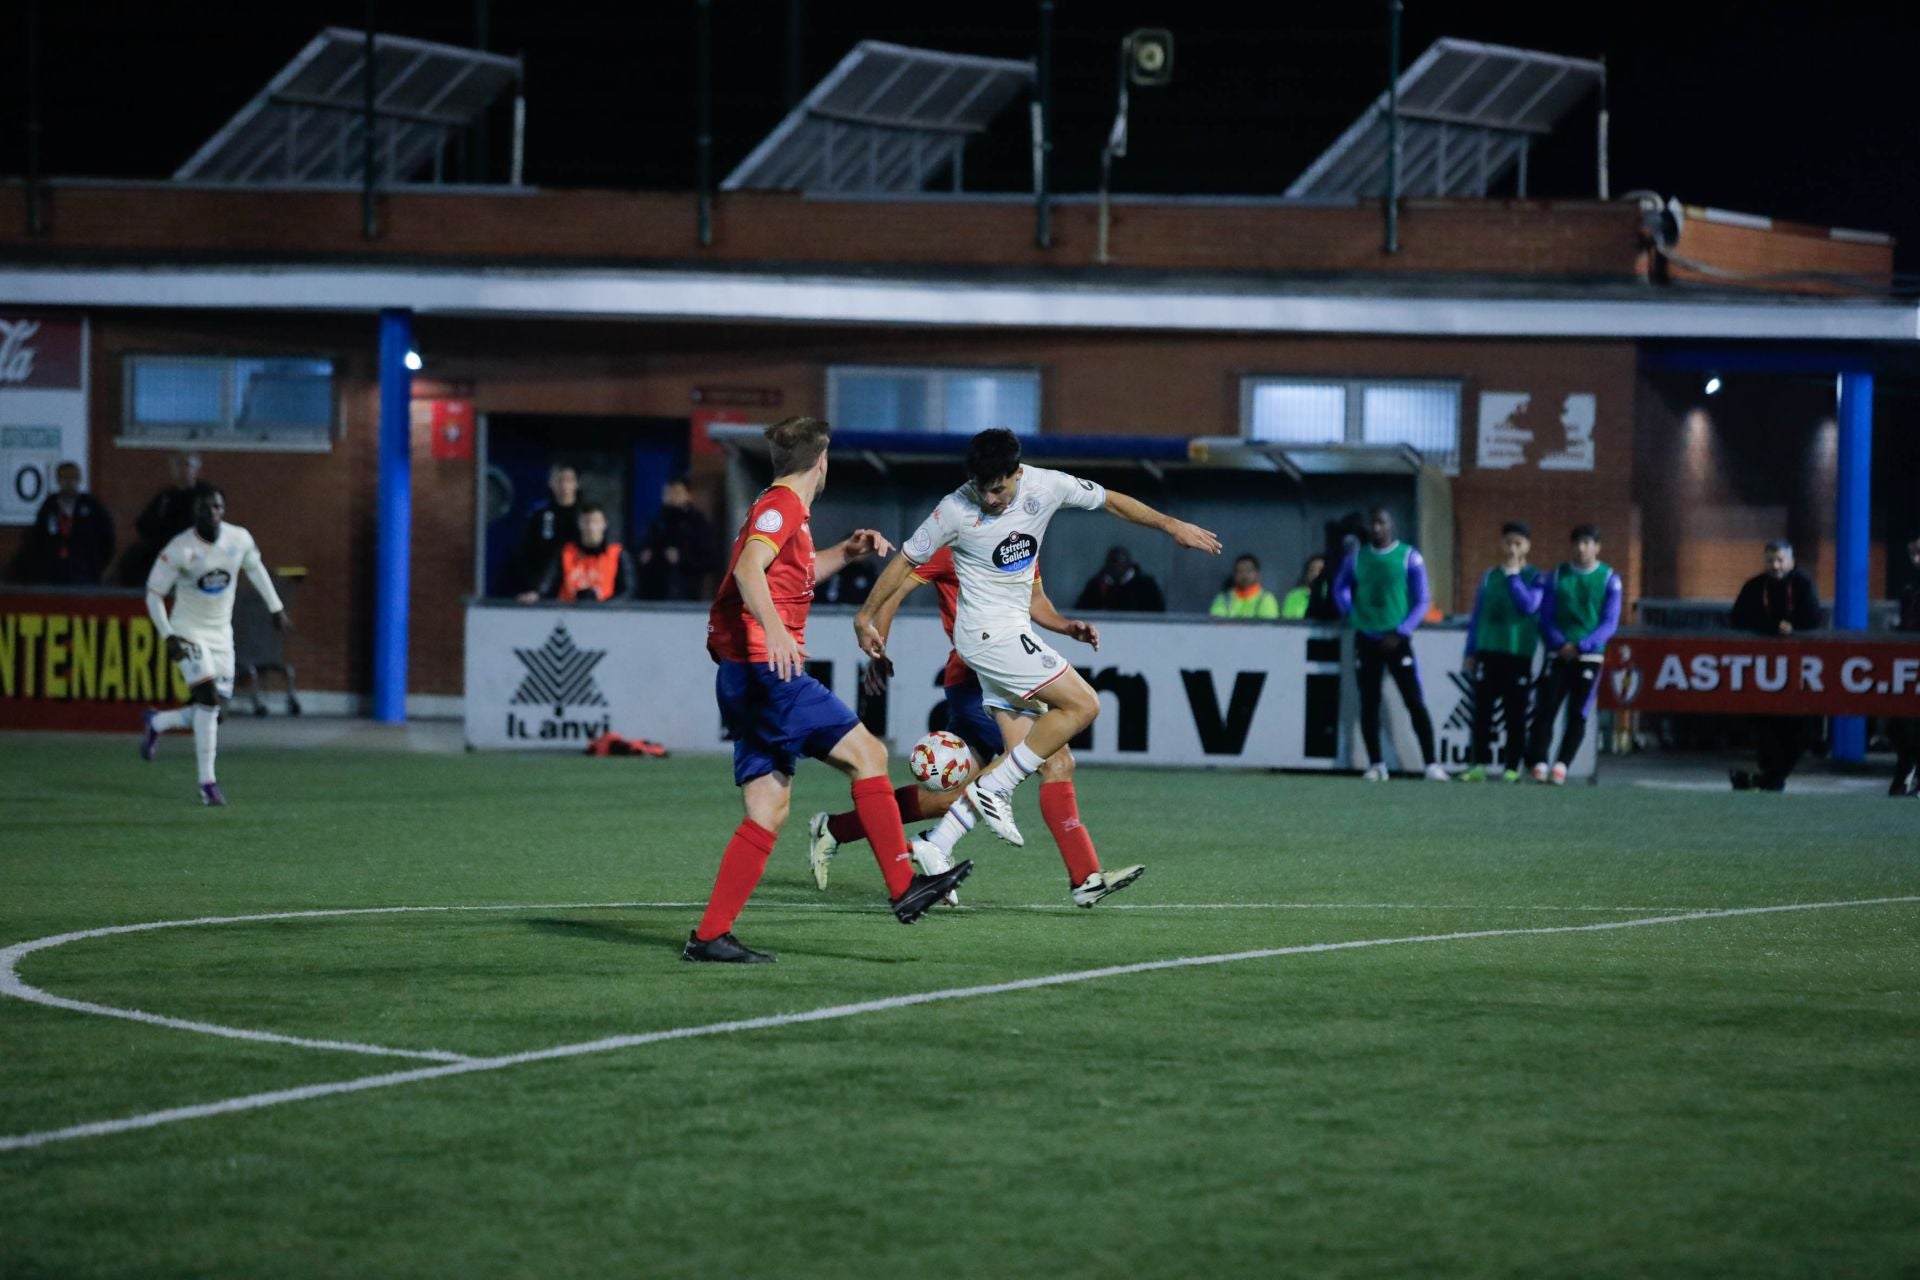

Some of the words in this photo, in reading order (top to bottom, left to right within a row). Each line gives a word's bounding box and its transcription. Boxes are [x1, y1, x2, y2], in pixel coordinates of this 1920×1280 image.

[1000, 540, 1031, 555] Estrella
[1001, 548, 1031, 565] Galicia
[1020, 633, 1043, 655] 4
[1653, 653, 1826, 693] ASTUR
